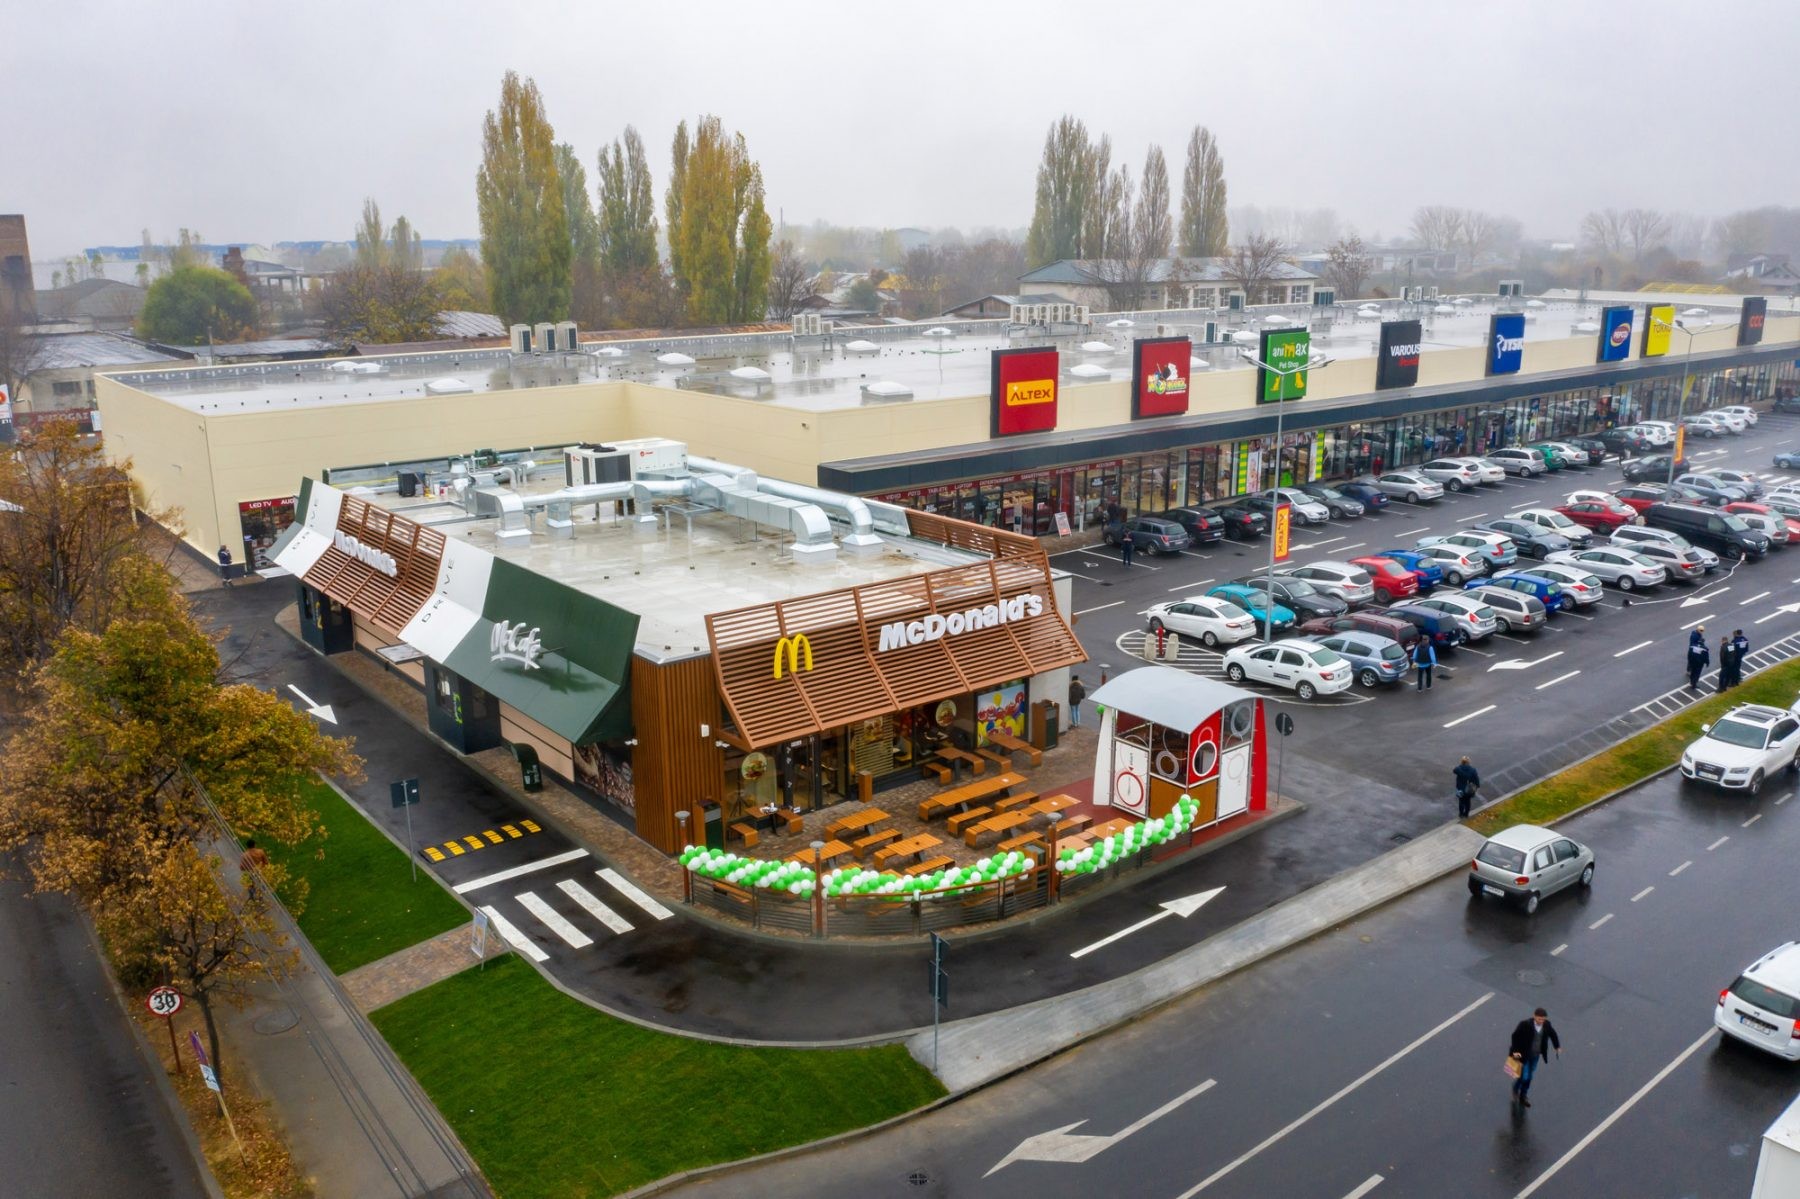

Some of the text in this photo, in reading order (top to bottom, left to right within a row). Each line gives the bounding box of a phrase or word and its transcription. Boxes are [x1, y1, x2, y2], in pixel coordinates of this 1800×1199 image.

[1390, 343, 1422, 357] VARIOUS
[421, 559, 455, 623] DRIVE
[879, 593, 1043, 653] McDonald's
[154, 993, 176, 1010] 30
